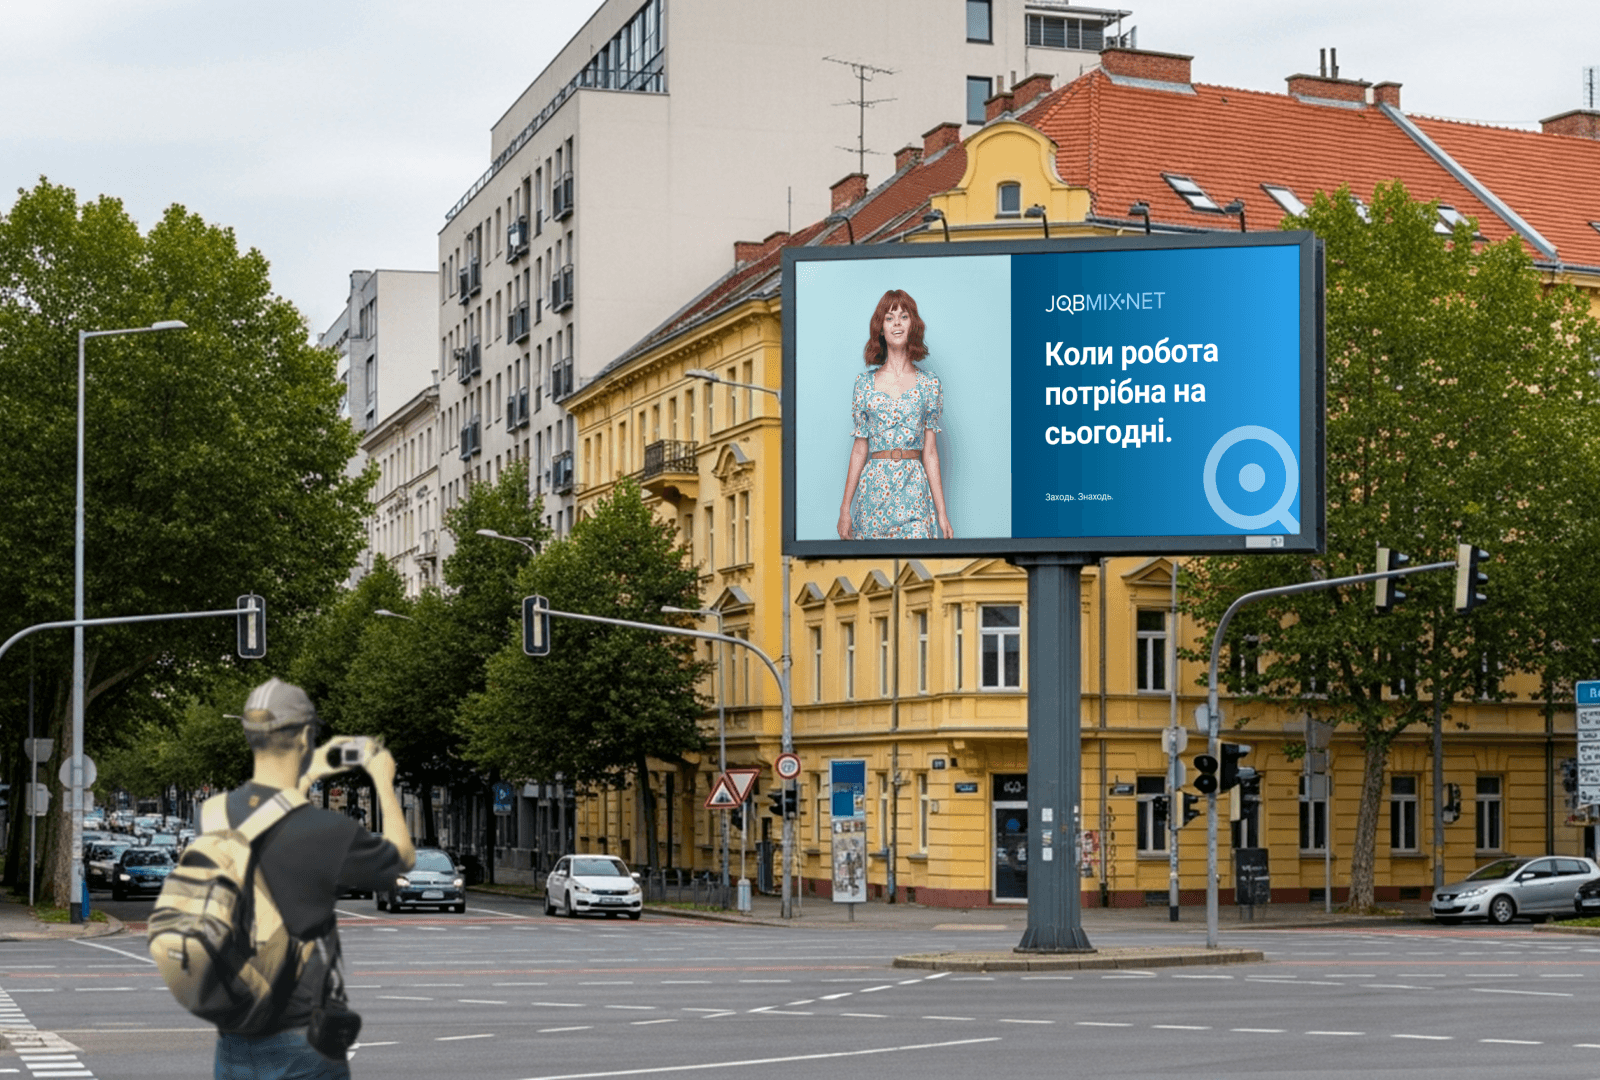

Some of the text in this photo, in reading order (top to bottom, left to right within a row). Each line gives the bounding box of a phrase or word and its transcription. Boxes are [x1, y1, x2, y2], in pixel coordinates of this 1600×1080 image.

[1045, 337, 1219, 371] Коли робота
[1045, 378, 1207, 411] потрібна на
[1045, 417, 1173, 448] сьогодні.
[1045, 492, 1114, 502] Заходь. Знаходь.
